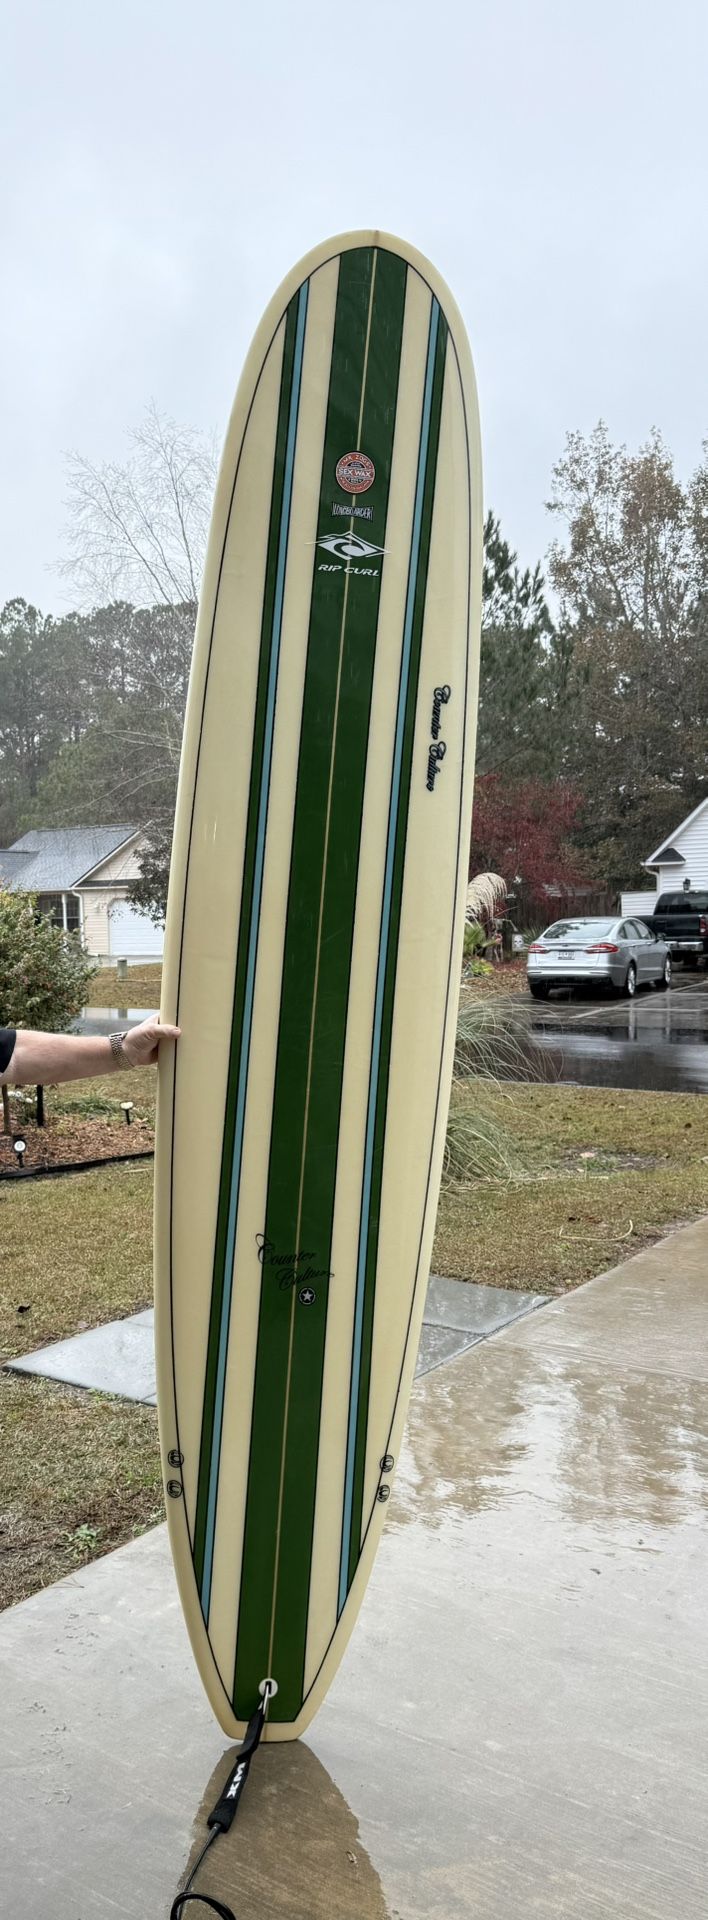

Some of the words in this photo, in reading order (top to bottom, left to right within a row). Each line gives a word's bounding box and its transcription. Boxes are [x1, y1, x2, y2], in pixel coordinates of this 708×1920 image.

[338, 468, 353, 476] SEX
[355, 469, 371, 478] WAX
[318, 564, 342, 572] RIP
[344, 567, 379, 576] CURL
[430, 684, 451, 740] Counter
[426, 741, 446, 792] Culture
[255, 1233, 316, 1265] Counter
